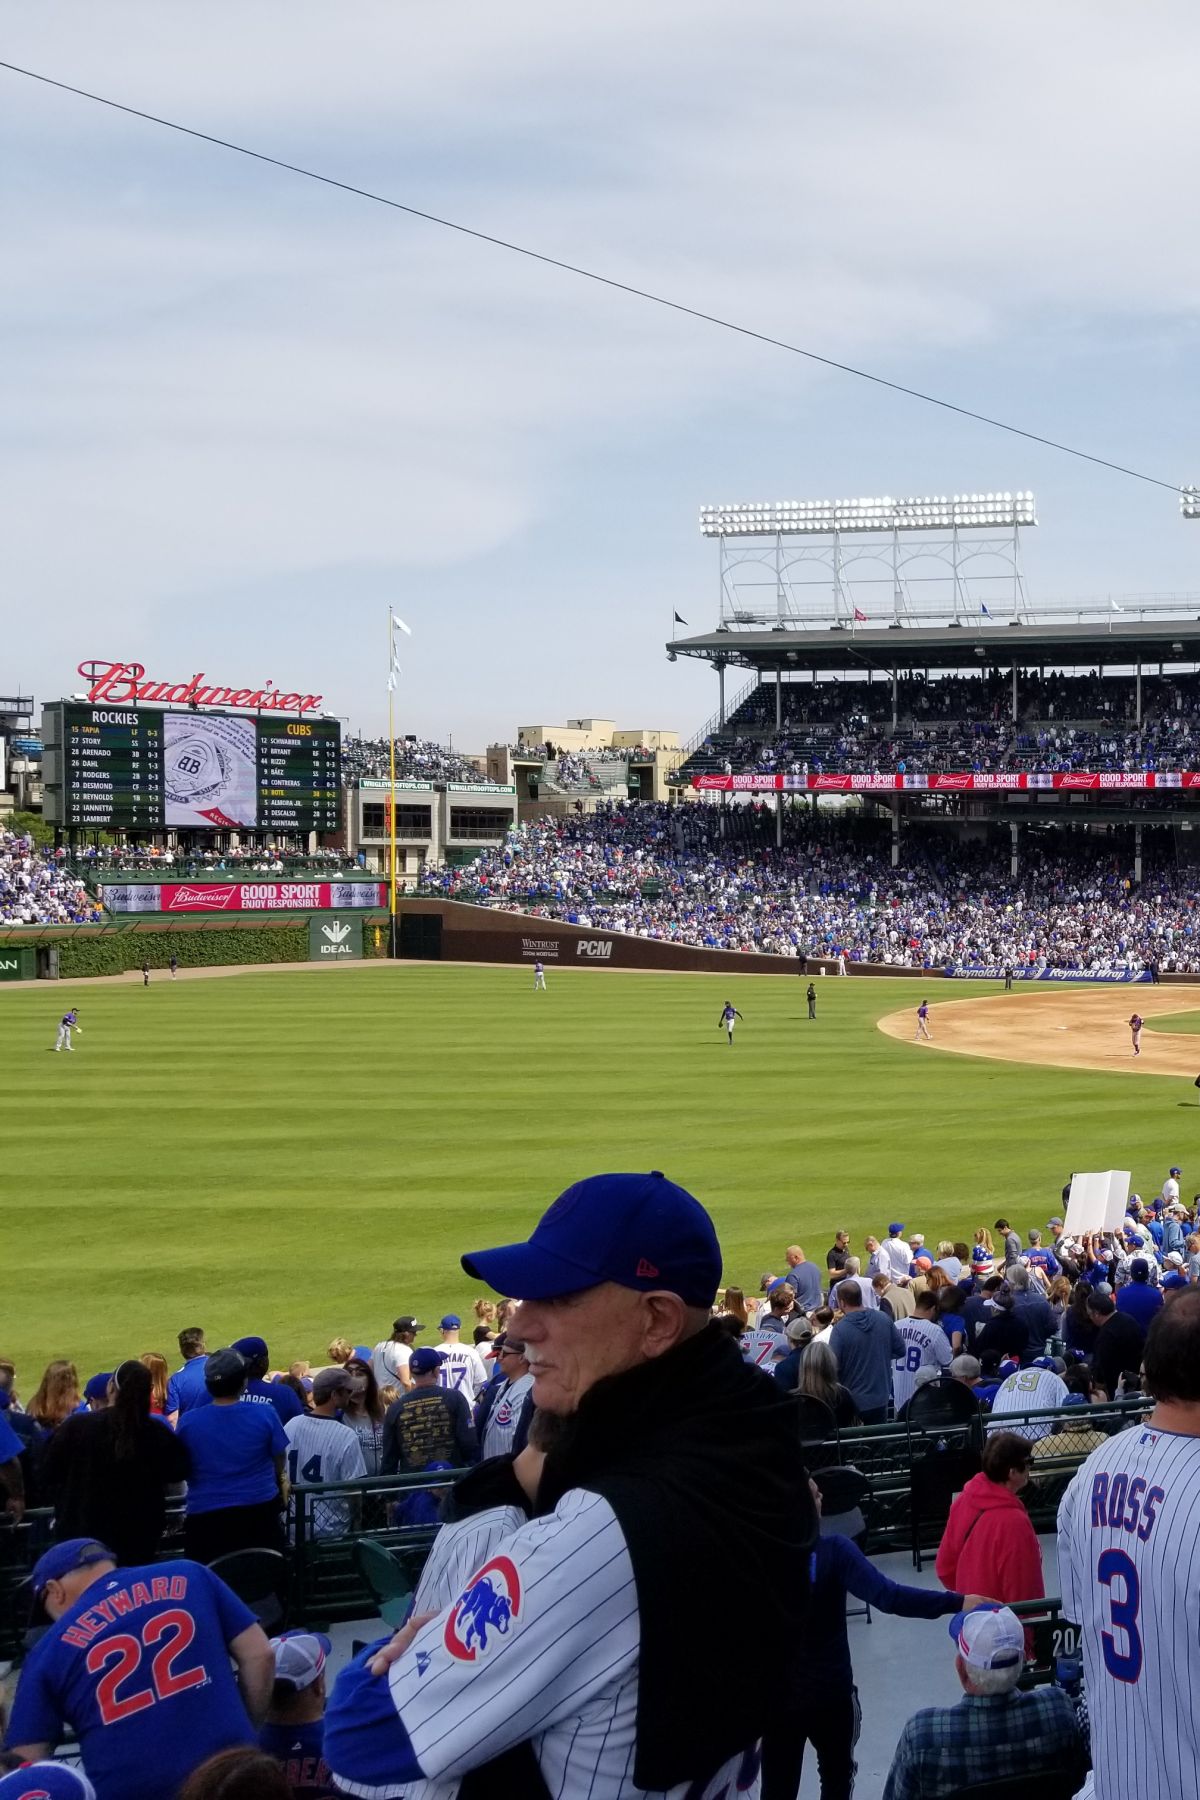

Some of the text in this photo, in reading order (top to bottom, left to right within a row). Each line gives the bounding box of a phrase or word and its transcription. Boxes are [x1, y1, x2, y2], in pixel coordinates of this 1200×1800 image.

[77, 660, 323, 712] Budweiser
[93, 711, 138, 724] ROCKIES
[287, 724, 312, 735] CUBS
[874, 775, 896, 783] SPORT
[974, 775, 994, 783] GOOD
[997, 775, 1019, 783] SPORT
[1100, 773, 1146, 782] GOOD SPORT
[175, 890, 229, 904] Budweiser
[241, 885, 320, 899] GOOD SPORT
[241, 899, 322, 909] ENJOY RESPONSIBLY.
[320, 945, 352, 953] IDEAL
[522, 939, 559, 948] WINTRUST
[577, 941, 612, 956] PCM
[953, 968, 998, 978] Reynolds
[1049, 968, 1124, 979] Reynolds Wrap
[1003, 1372, 1042, 1393] 49
[288, 1450, 324, 1484] 14
[1091, 1471, 1165, 1543] ROSS
[61, 1575, 188, 1649] HEYWARD
[1097, 1547, 1144, 1685] 3
[86, 1608, 207, 1726] 22
